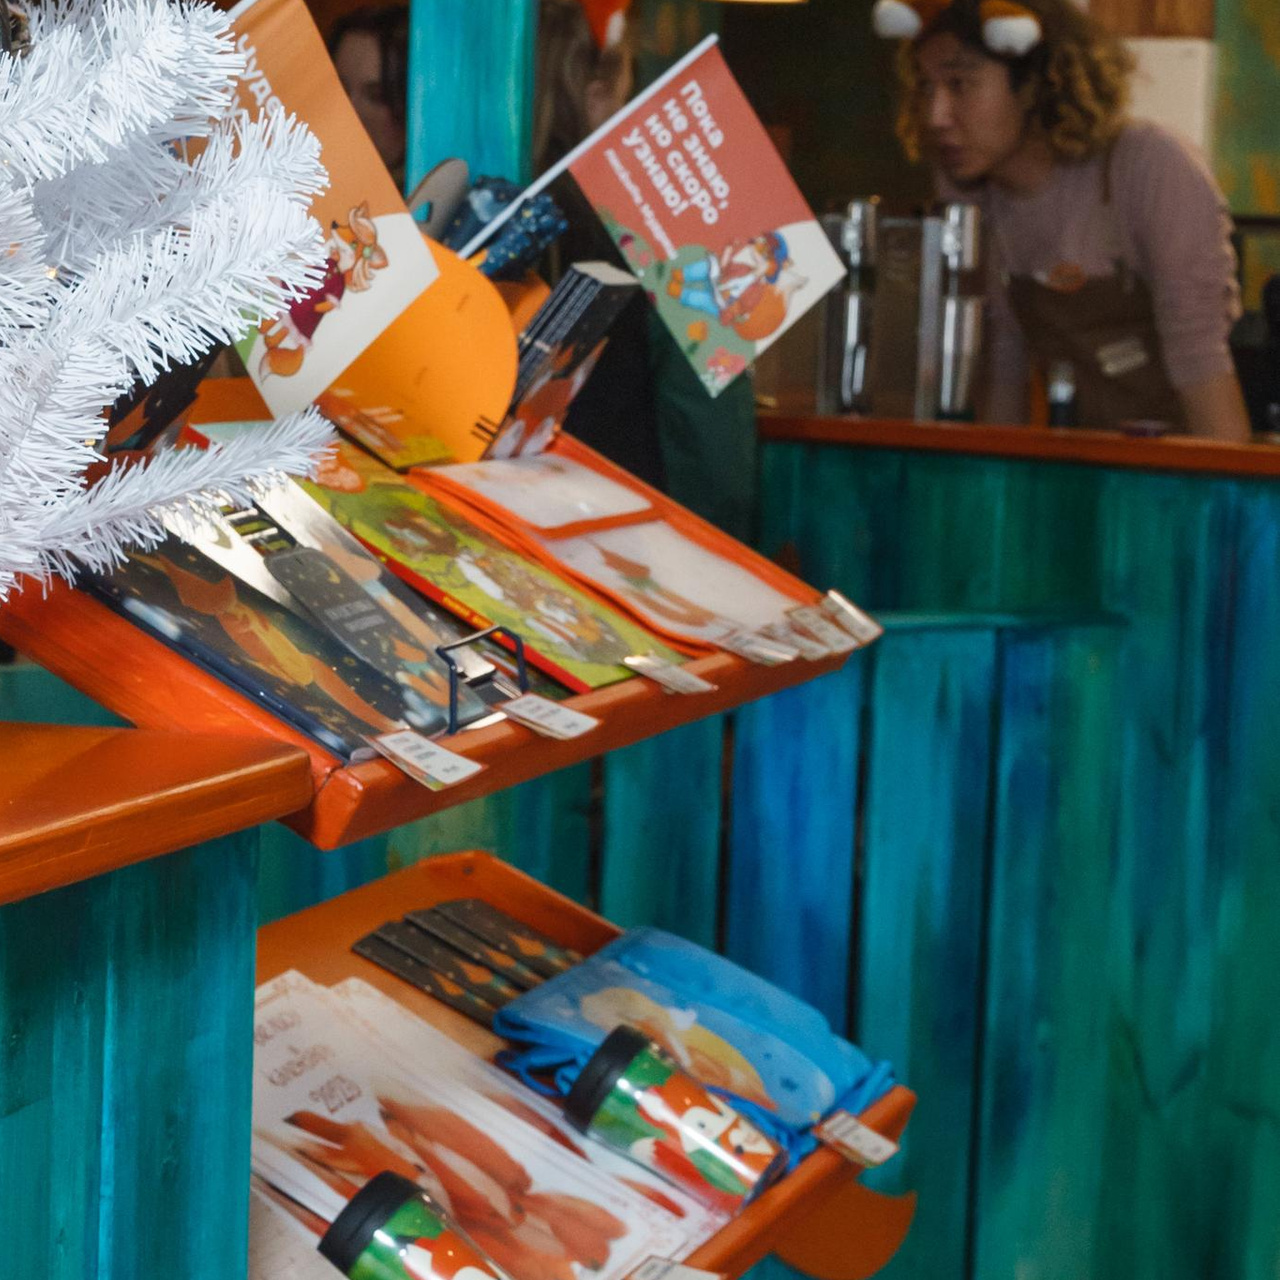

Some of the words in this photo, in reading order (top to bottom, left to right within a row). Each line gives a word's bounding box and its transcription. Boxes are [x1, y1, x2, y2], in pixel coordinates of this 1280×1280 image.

[662, 98, 689, 133] не
[683, 133, 730, 209] знаю,
[680, 80, 724, 148] Пока
[621, 127, 689, 216] узнаю!
[644, 114, 673, 148] но
[666, 150, 719, 225] скоро
